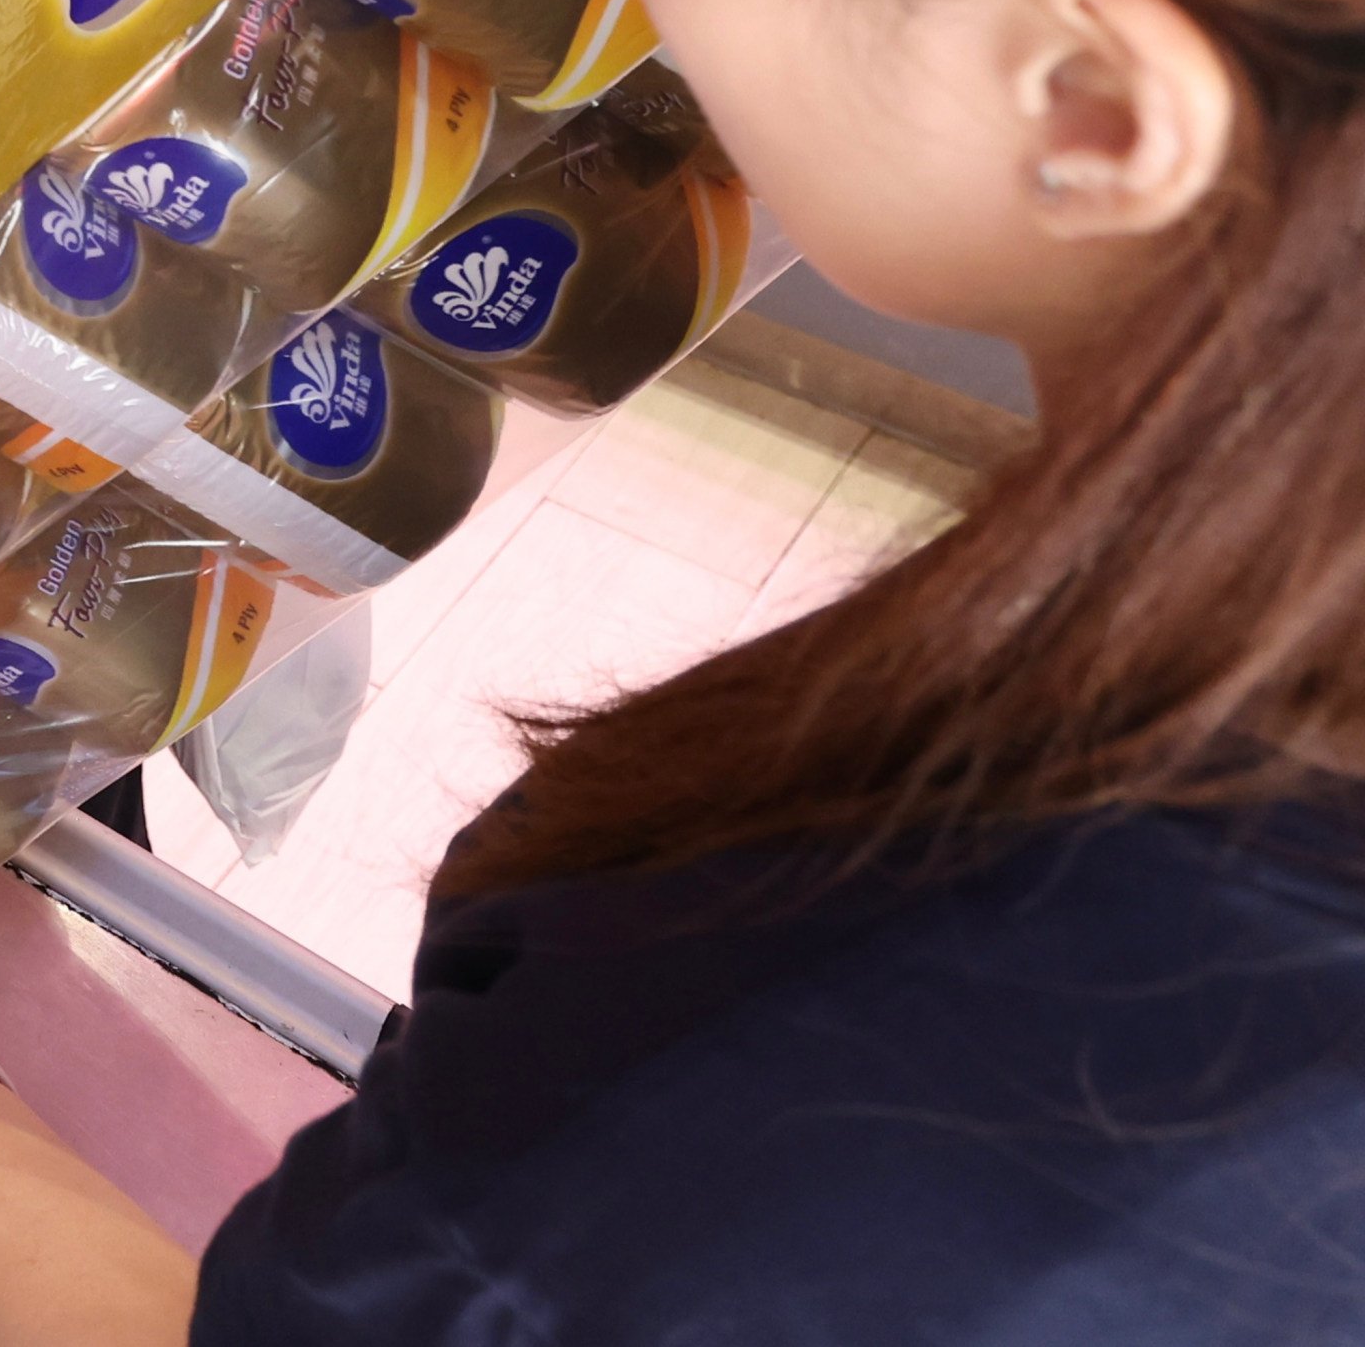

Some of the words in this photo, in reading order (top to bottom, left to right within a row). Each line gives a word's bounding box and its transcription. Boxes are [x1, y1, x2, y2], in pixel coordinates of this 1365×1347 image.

[445, 117, 459, 134] 4
[452, 85, 472, 119] Ply
[145, 173, 211, 228] Vinda
[470, 256, 544, 331] Vinda
[329, 331, 362, 431] Vinda
[37, 518, 83, 597] Golden
[46, 505, 124, 640] Four-Ply
[232, 631, 247, 646] 4
[236, 601, 260, 634] Ply
